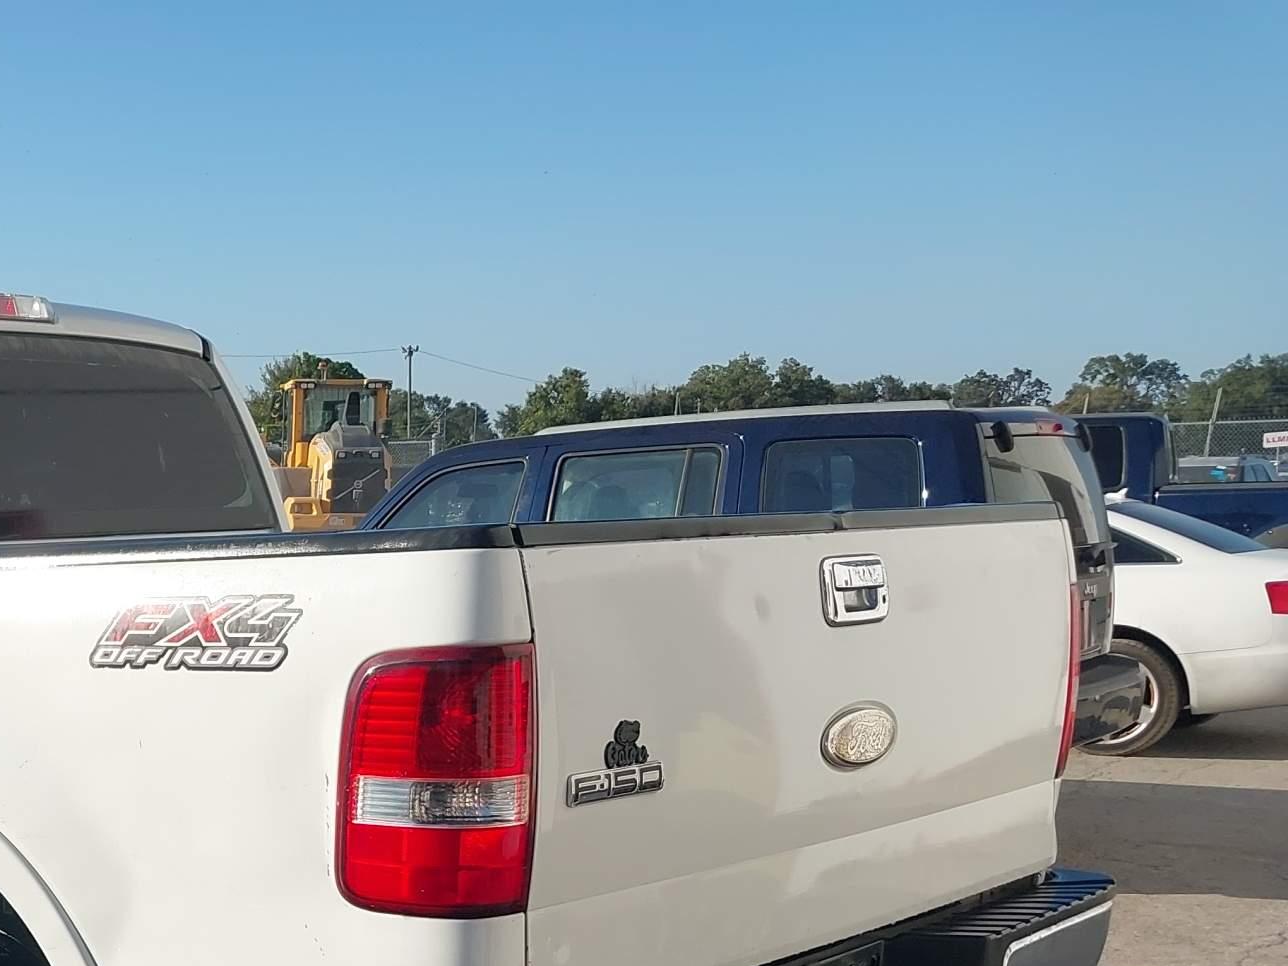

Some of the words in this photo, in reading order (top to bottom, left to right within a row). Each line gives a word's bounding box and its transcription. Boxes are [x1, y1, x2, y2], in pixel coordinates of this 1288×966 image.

[97, 595, 301, 648] FX4
[92, 647, 163, 667] OFF
[168, 647, 287, 669] ROAD
